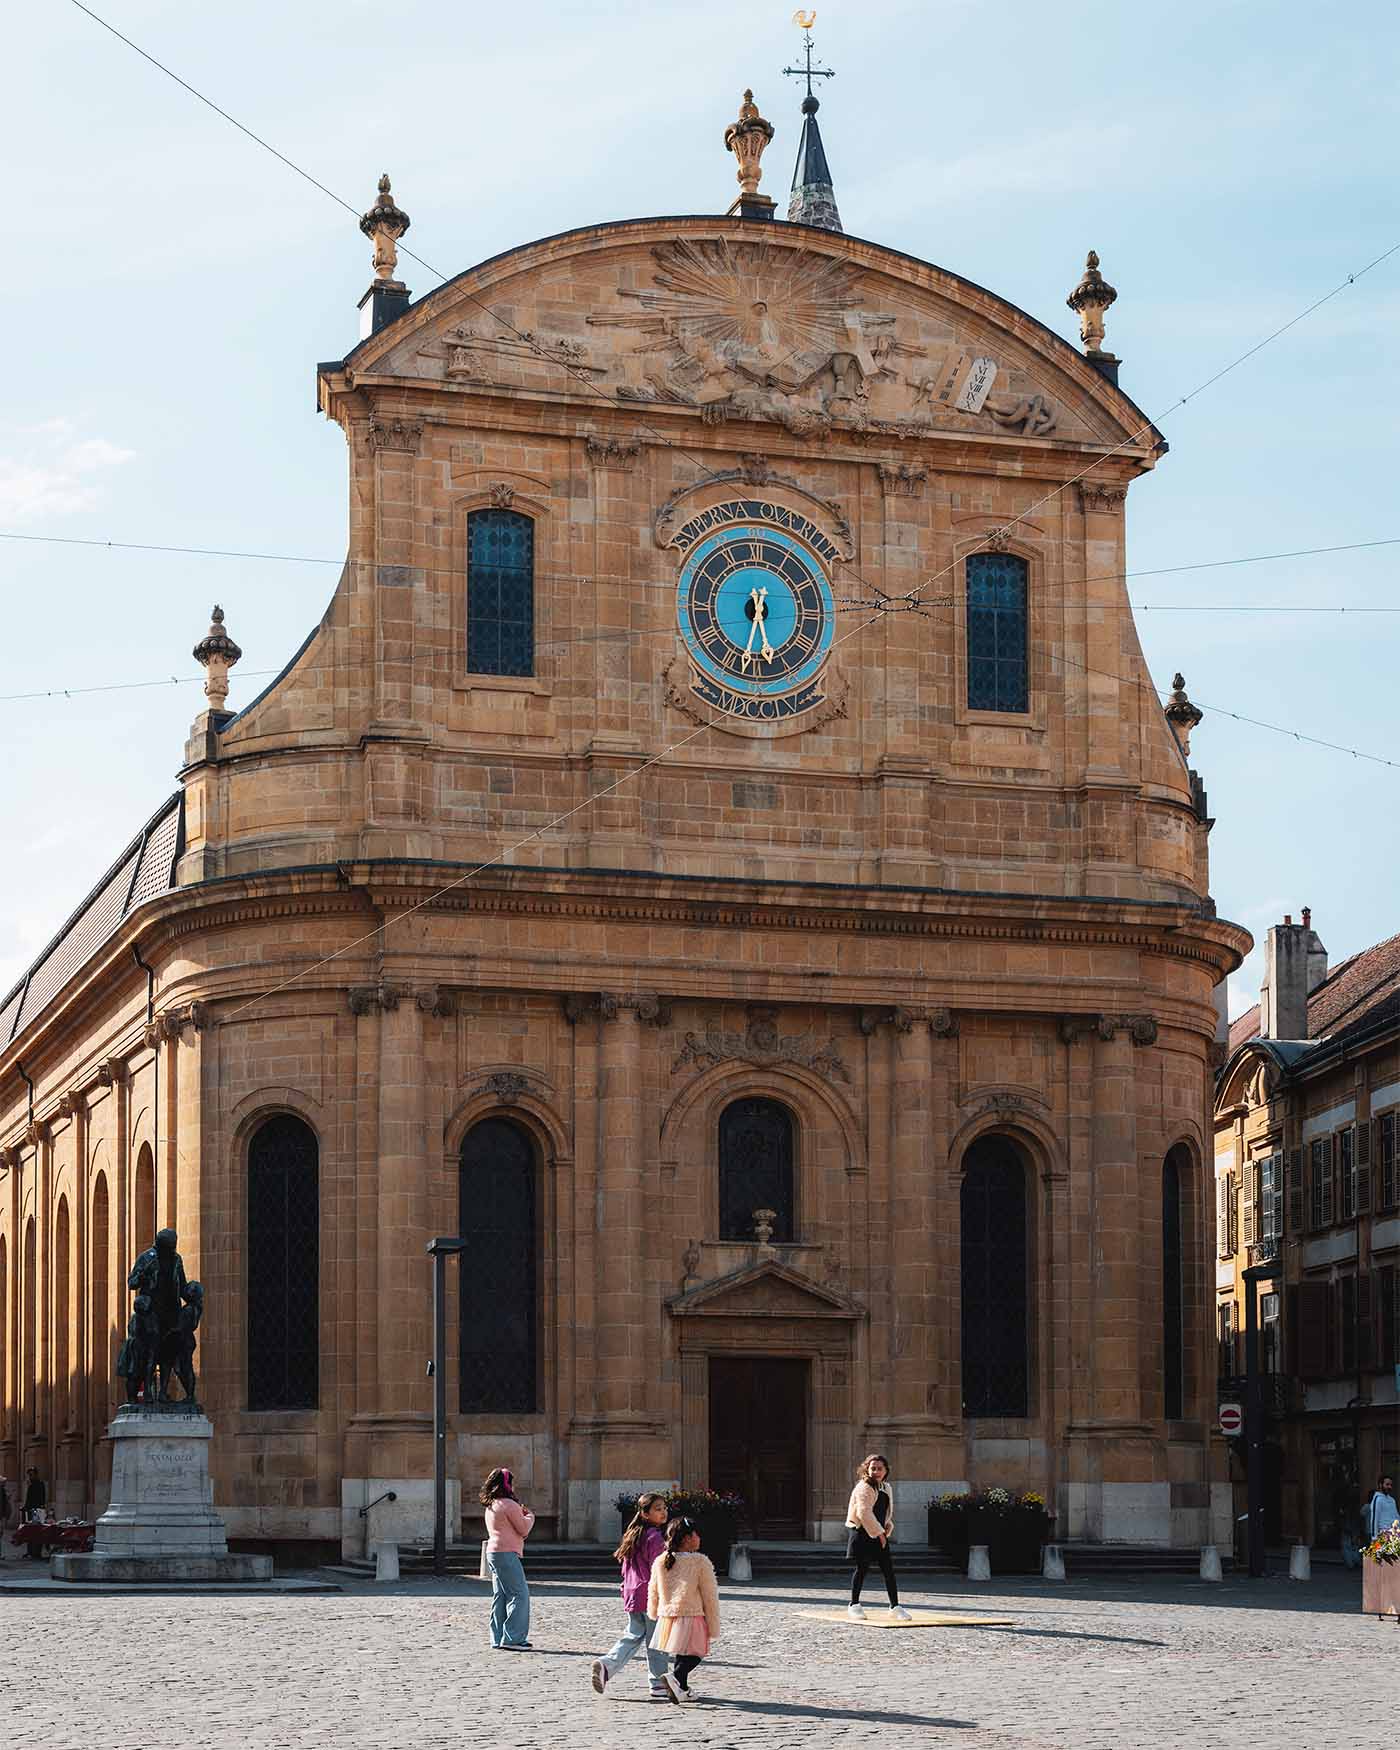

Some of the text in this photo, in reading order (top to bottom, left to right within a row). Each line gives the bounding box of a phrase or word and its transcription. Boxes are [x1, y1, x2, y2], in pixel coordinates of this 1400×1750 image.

[978, 366, 988, 376] VI
[975, 374, 986, 384] VII
[970, 383, 983, 393] VIII
[966, 392, 976, 402] IX
[674, 502, 752, 551] SVPERNA
[721, 547, 737, 568] XI
[749, 544, 763, 561] XII
[803, 608, 819, 620] III
[717, 690, 797, 718] MDCCLV
